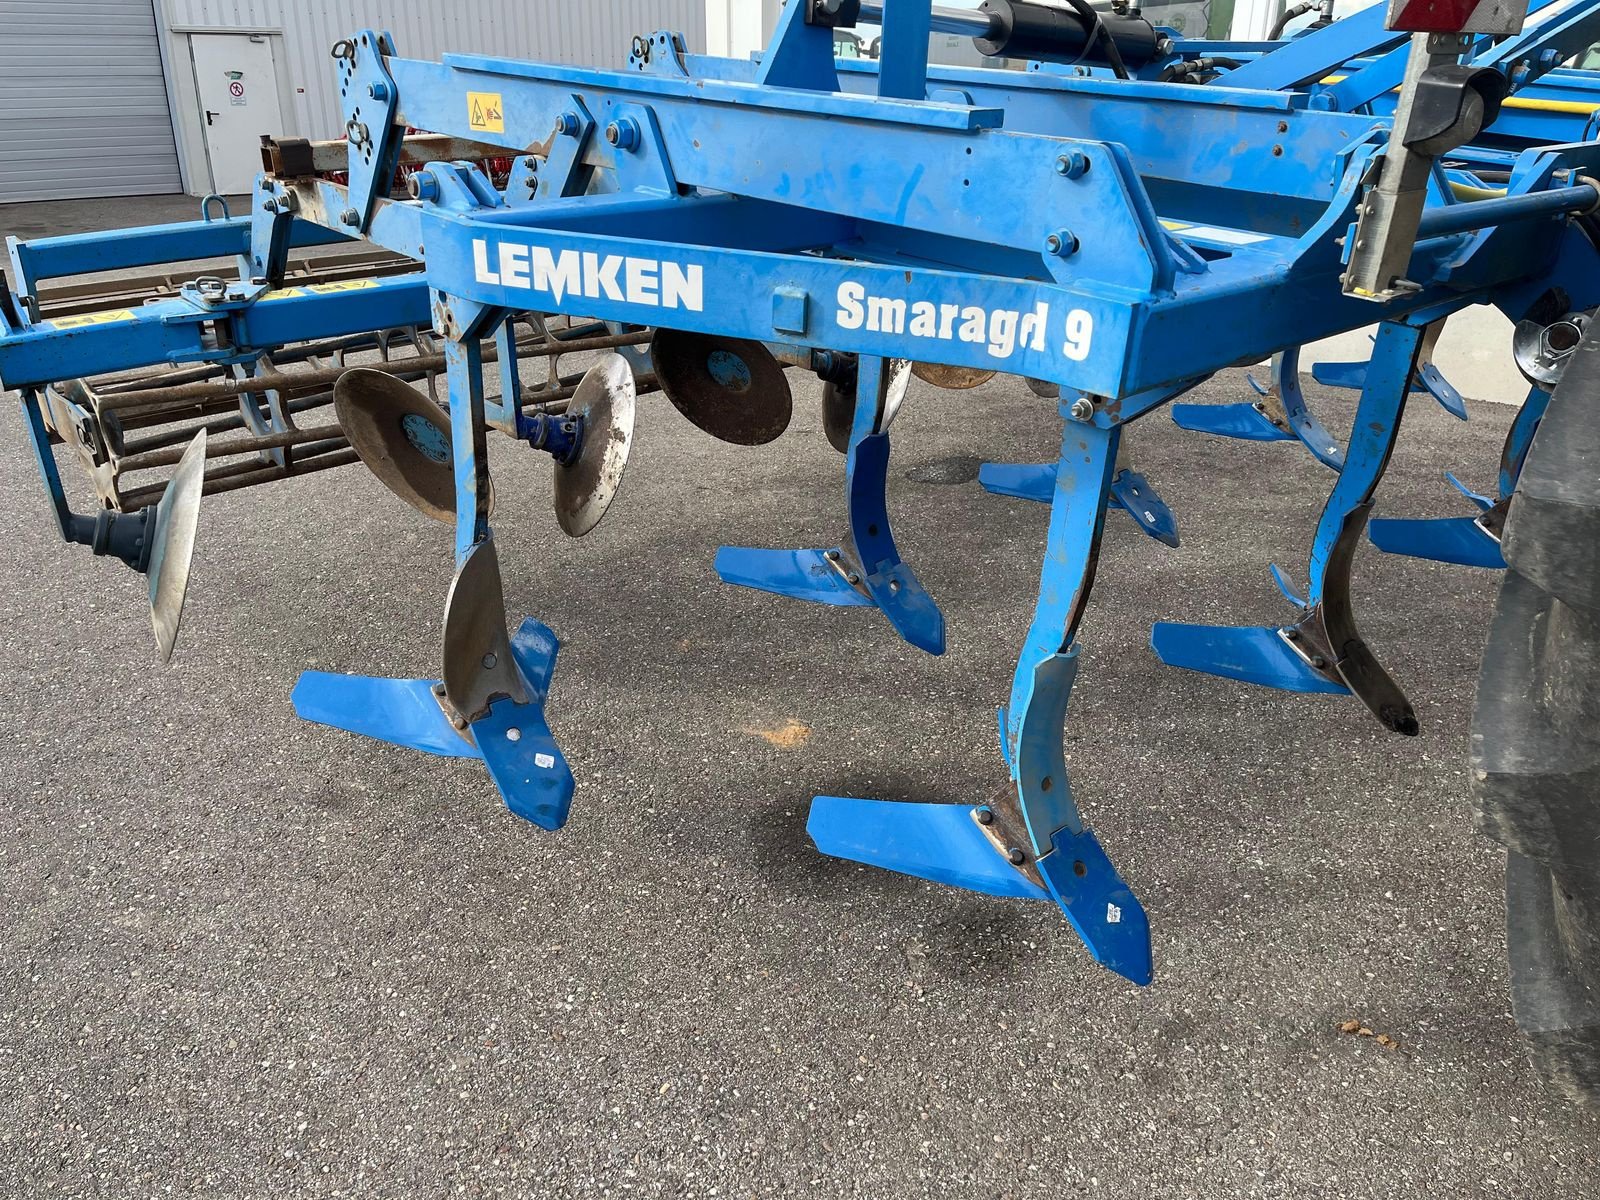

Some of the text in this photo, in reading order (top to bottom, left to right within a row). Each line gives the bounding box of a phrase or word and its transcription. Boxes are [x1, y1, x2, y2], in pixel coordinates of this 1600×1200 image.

[472, 239, 703, 312] LEMKEN
[836, 281, 1094, 362] Smaragd 9
